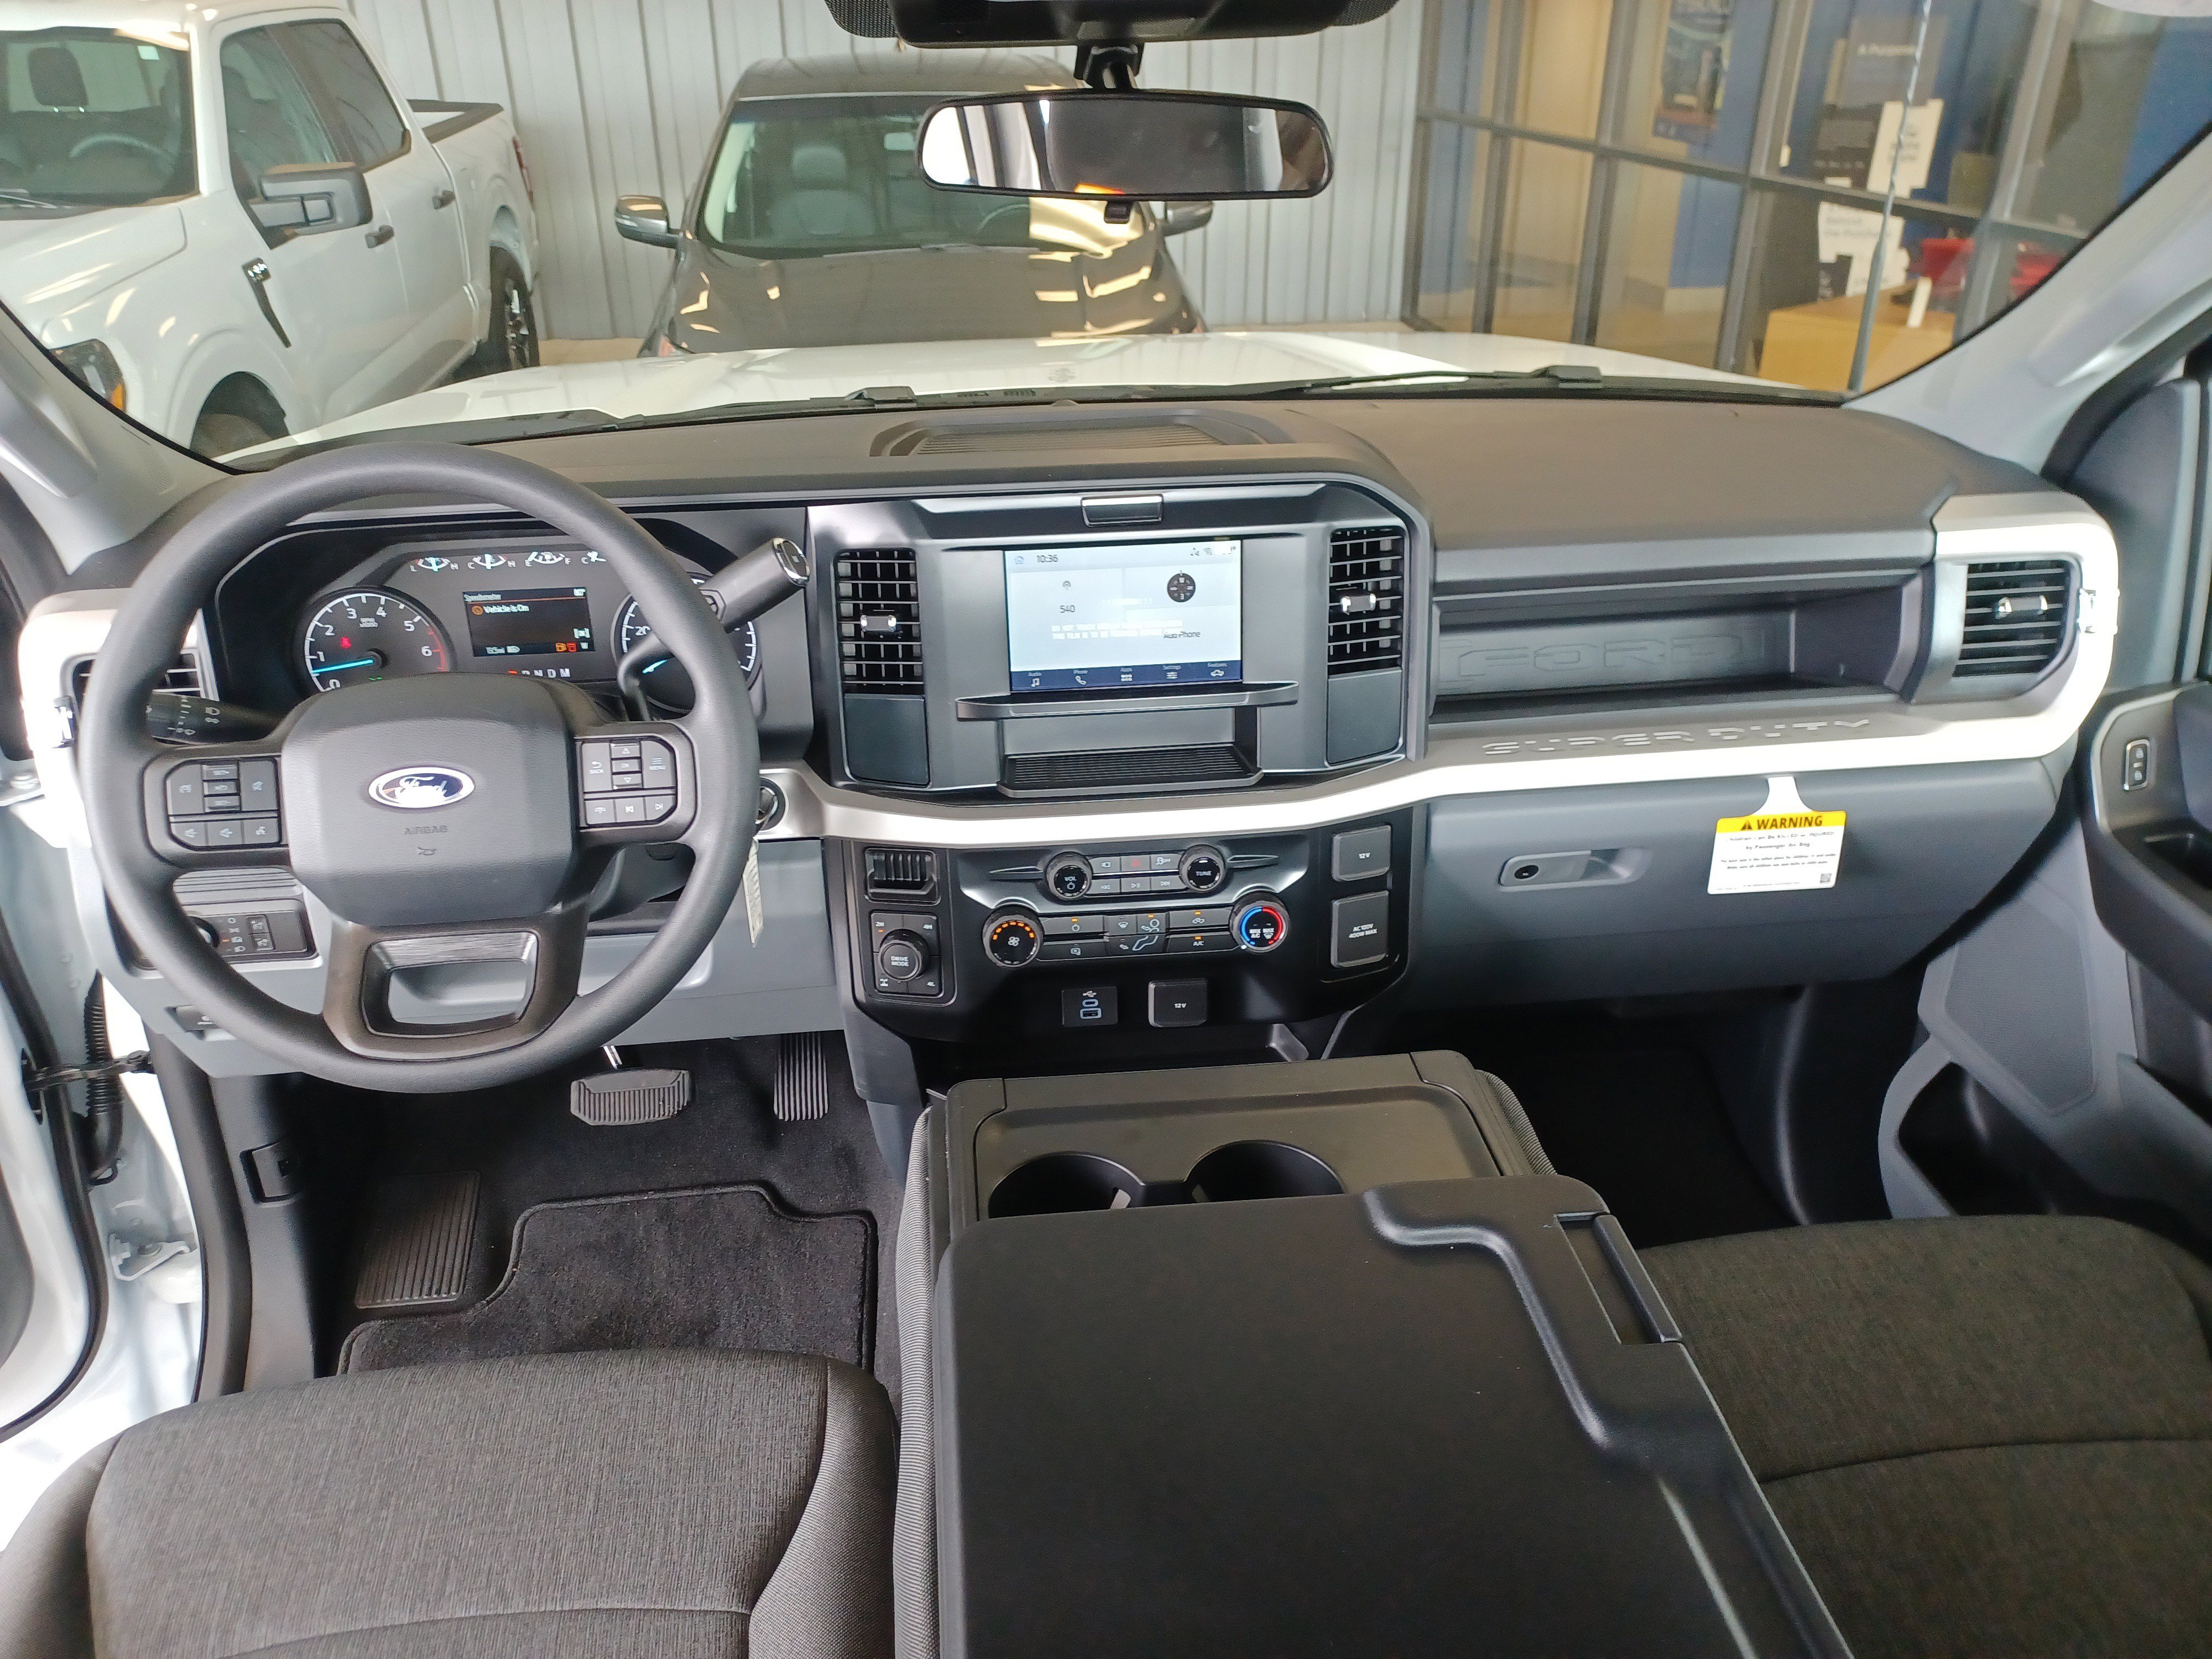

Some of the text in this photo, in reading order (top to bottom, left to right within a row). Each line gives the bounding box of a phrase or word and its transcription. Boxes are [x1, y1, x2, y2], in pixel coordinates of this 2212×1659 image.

[346, 608, 357, 619] 3
[376, 606, 387, 618] 4
[325, 625, 335, 635] 2
[404, 620, 415, 632] 5
[317, 651, 325, 662] 1
[421, 646, 432, 656] 6
[1458, 633, 1744, 677] FORD
[1483, 719, 1870, 755] SUPER DUTY
[1756, 816, 1823, 830] WARNING
